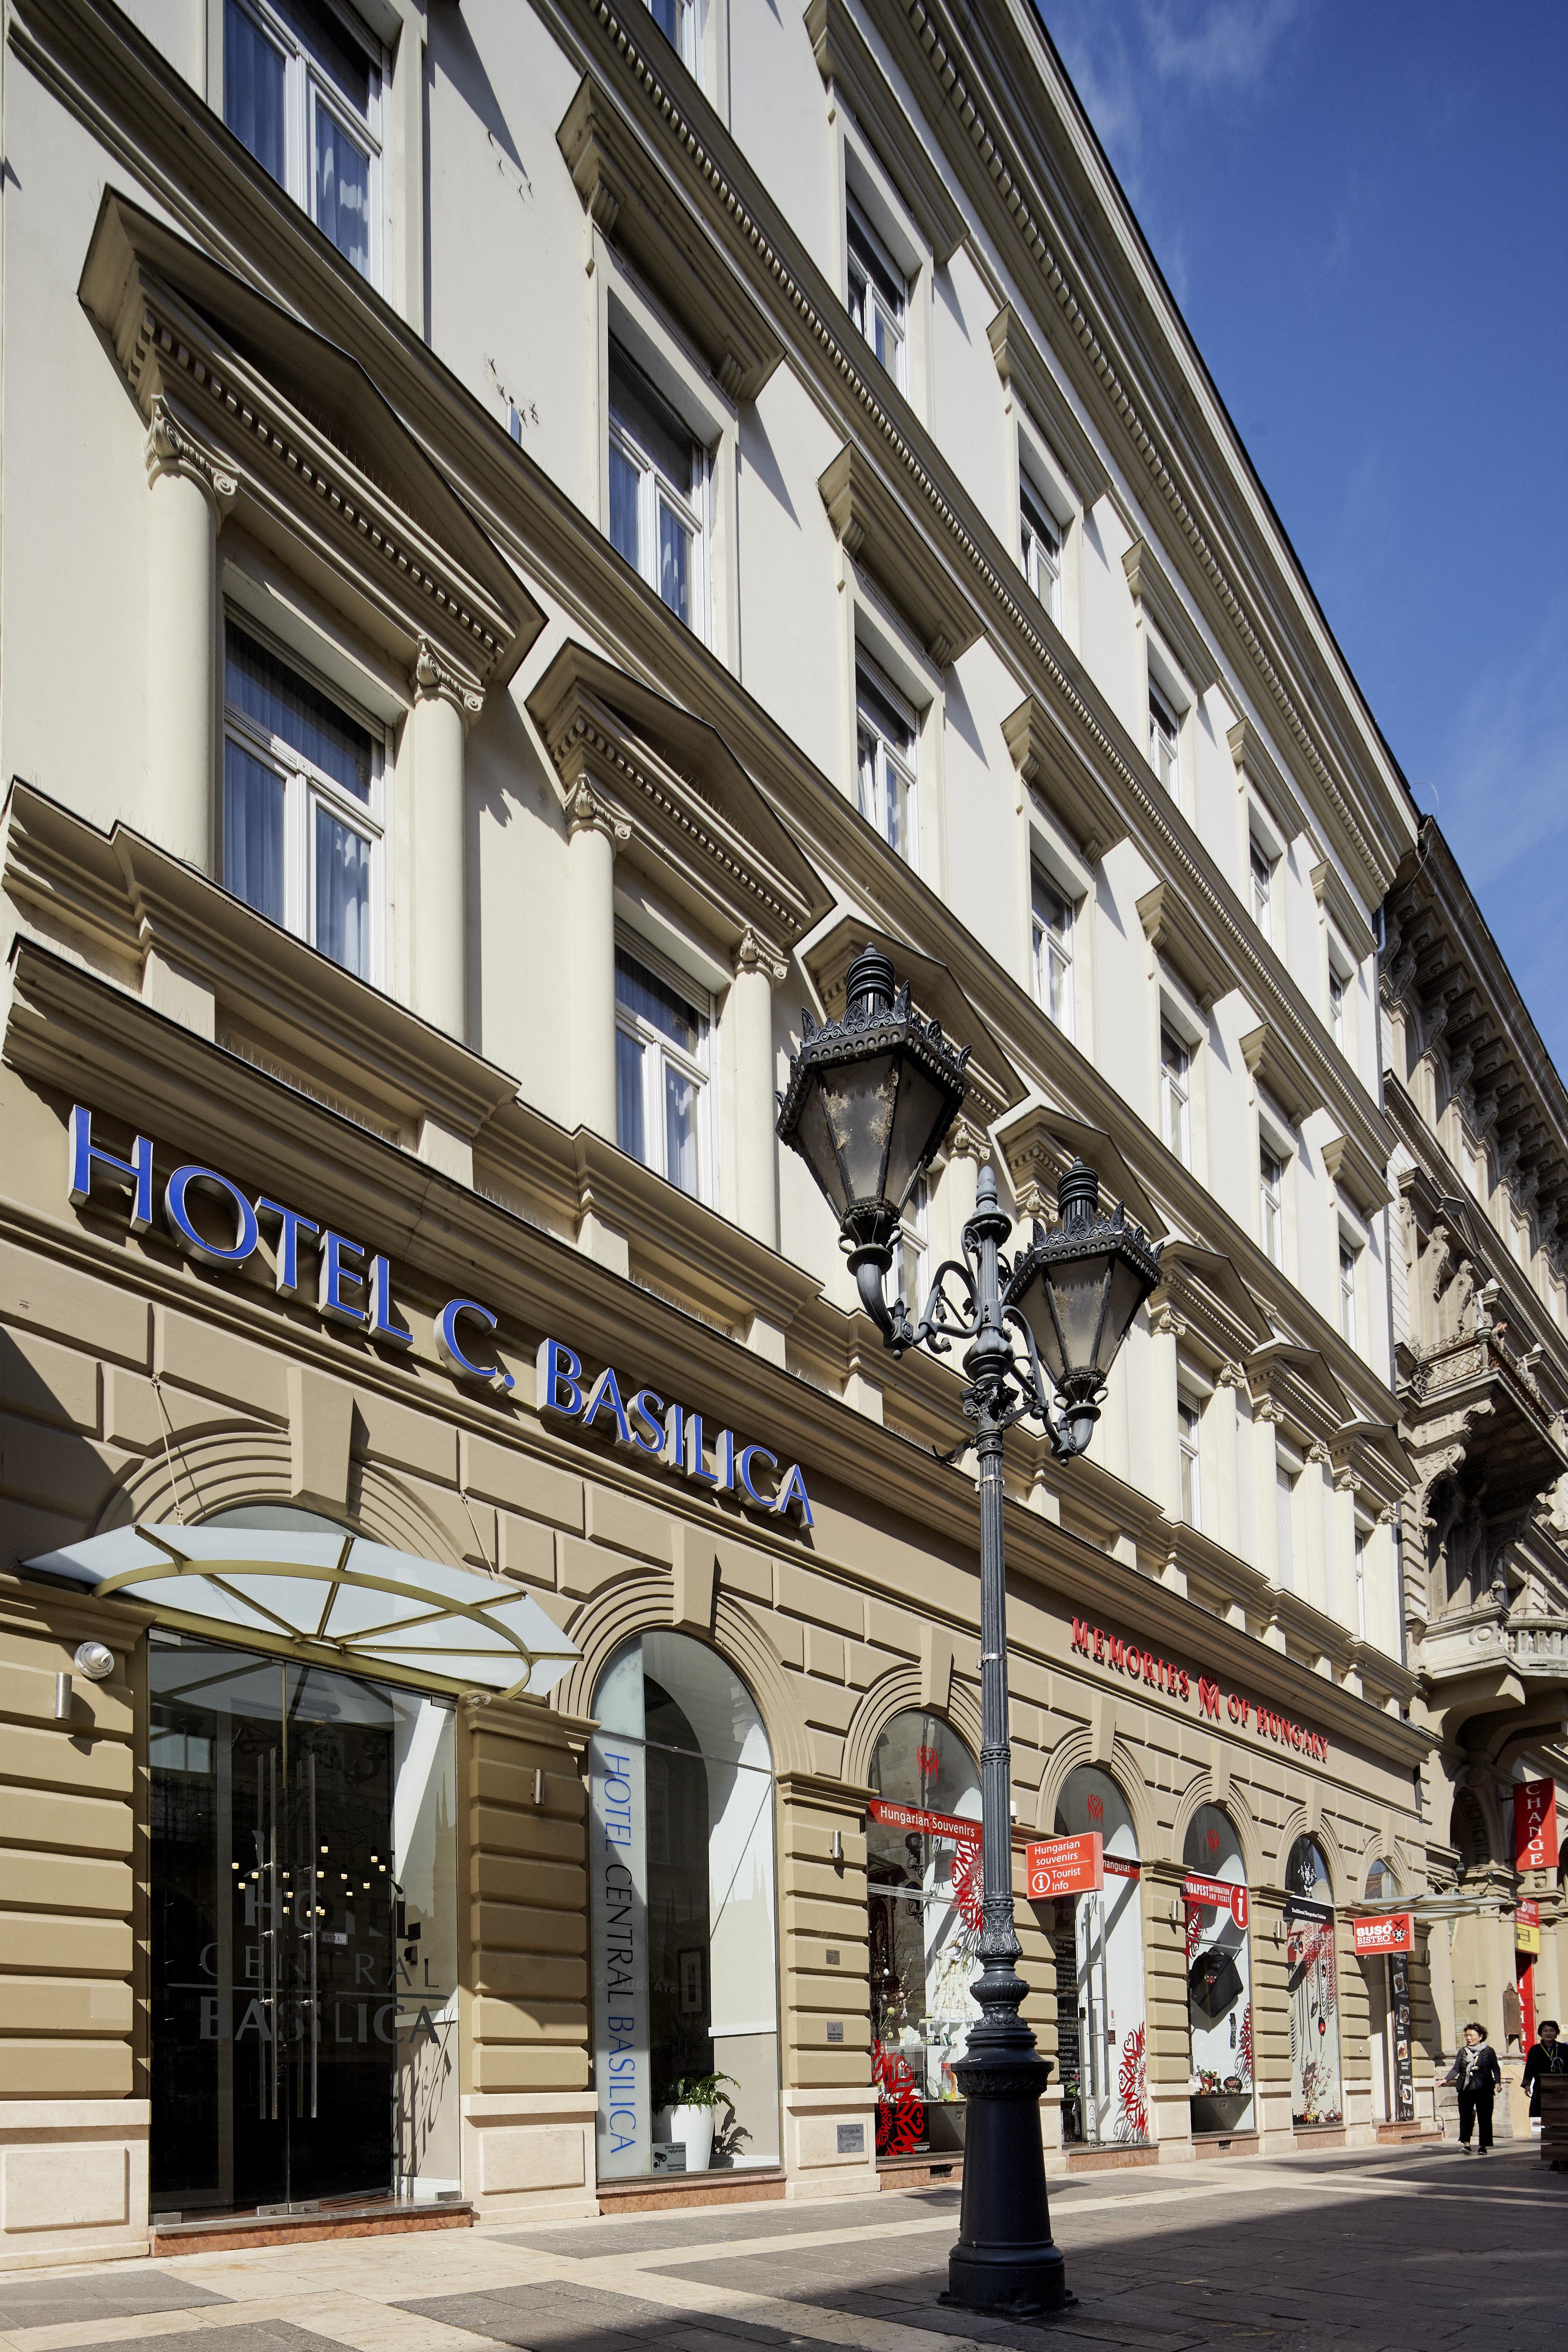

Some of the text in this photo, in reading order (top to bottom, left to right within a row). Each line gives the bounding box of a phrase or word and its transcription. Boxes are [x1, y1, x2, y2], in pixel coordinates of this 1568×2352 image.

[69, 1105, 815, 1529] HOTEL C. BASILICA
[1071, 1616, 1329, 1760] MEMORIES OF HUNGARY
[880, 1806, 975, 1837] Hungarian Souvenirs
[1525, 1784, 1544, 1865] CHANGE
[1034, 1841, 1080, 1855] Hungarian
[1036, 1852, 1078, 1866] souvenirs
[1051, 1867, 1081, 1879] Tourist
[1052, 1880, 1069, 1891] Info
[1183, 1882, 1209, 1896] BUDAPEST
[1209, 1885, 1229, 1896] INFORMATION
[1357, 1935, 1390, 1945] BISTRO
[605, 1753, 636, 2153] HOTEL CENTRAL BASILICA
[200, 1942, 439, 1988] CENTRAL
[200, 1996, 441, 2046] BASILICA
